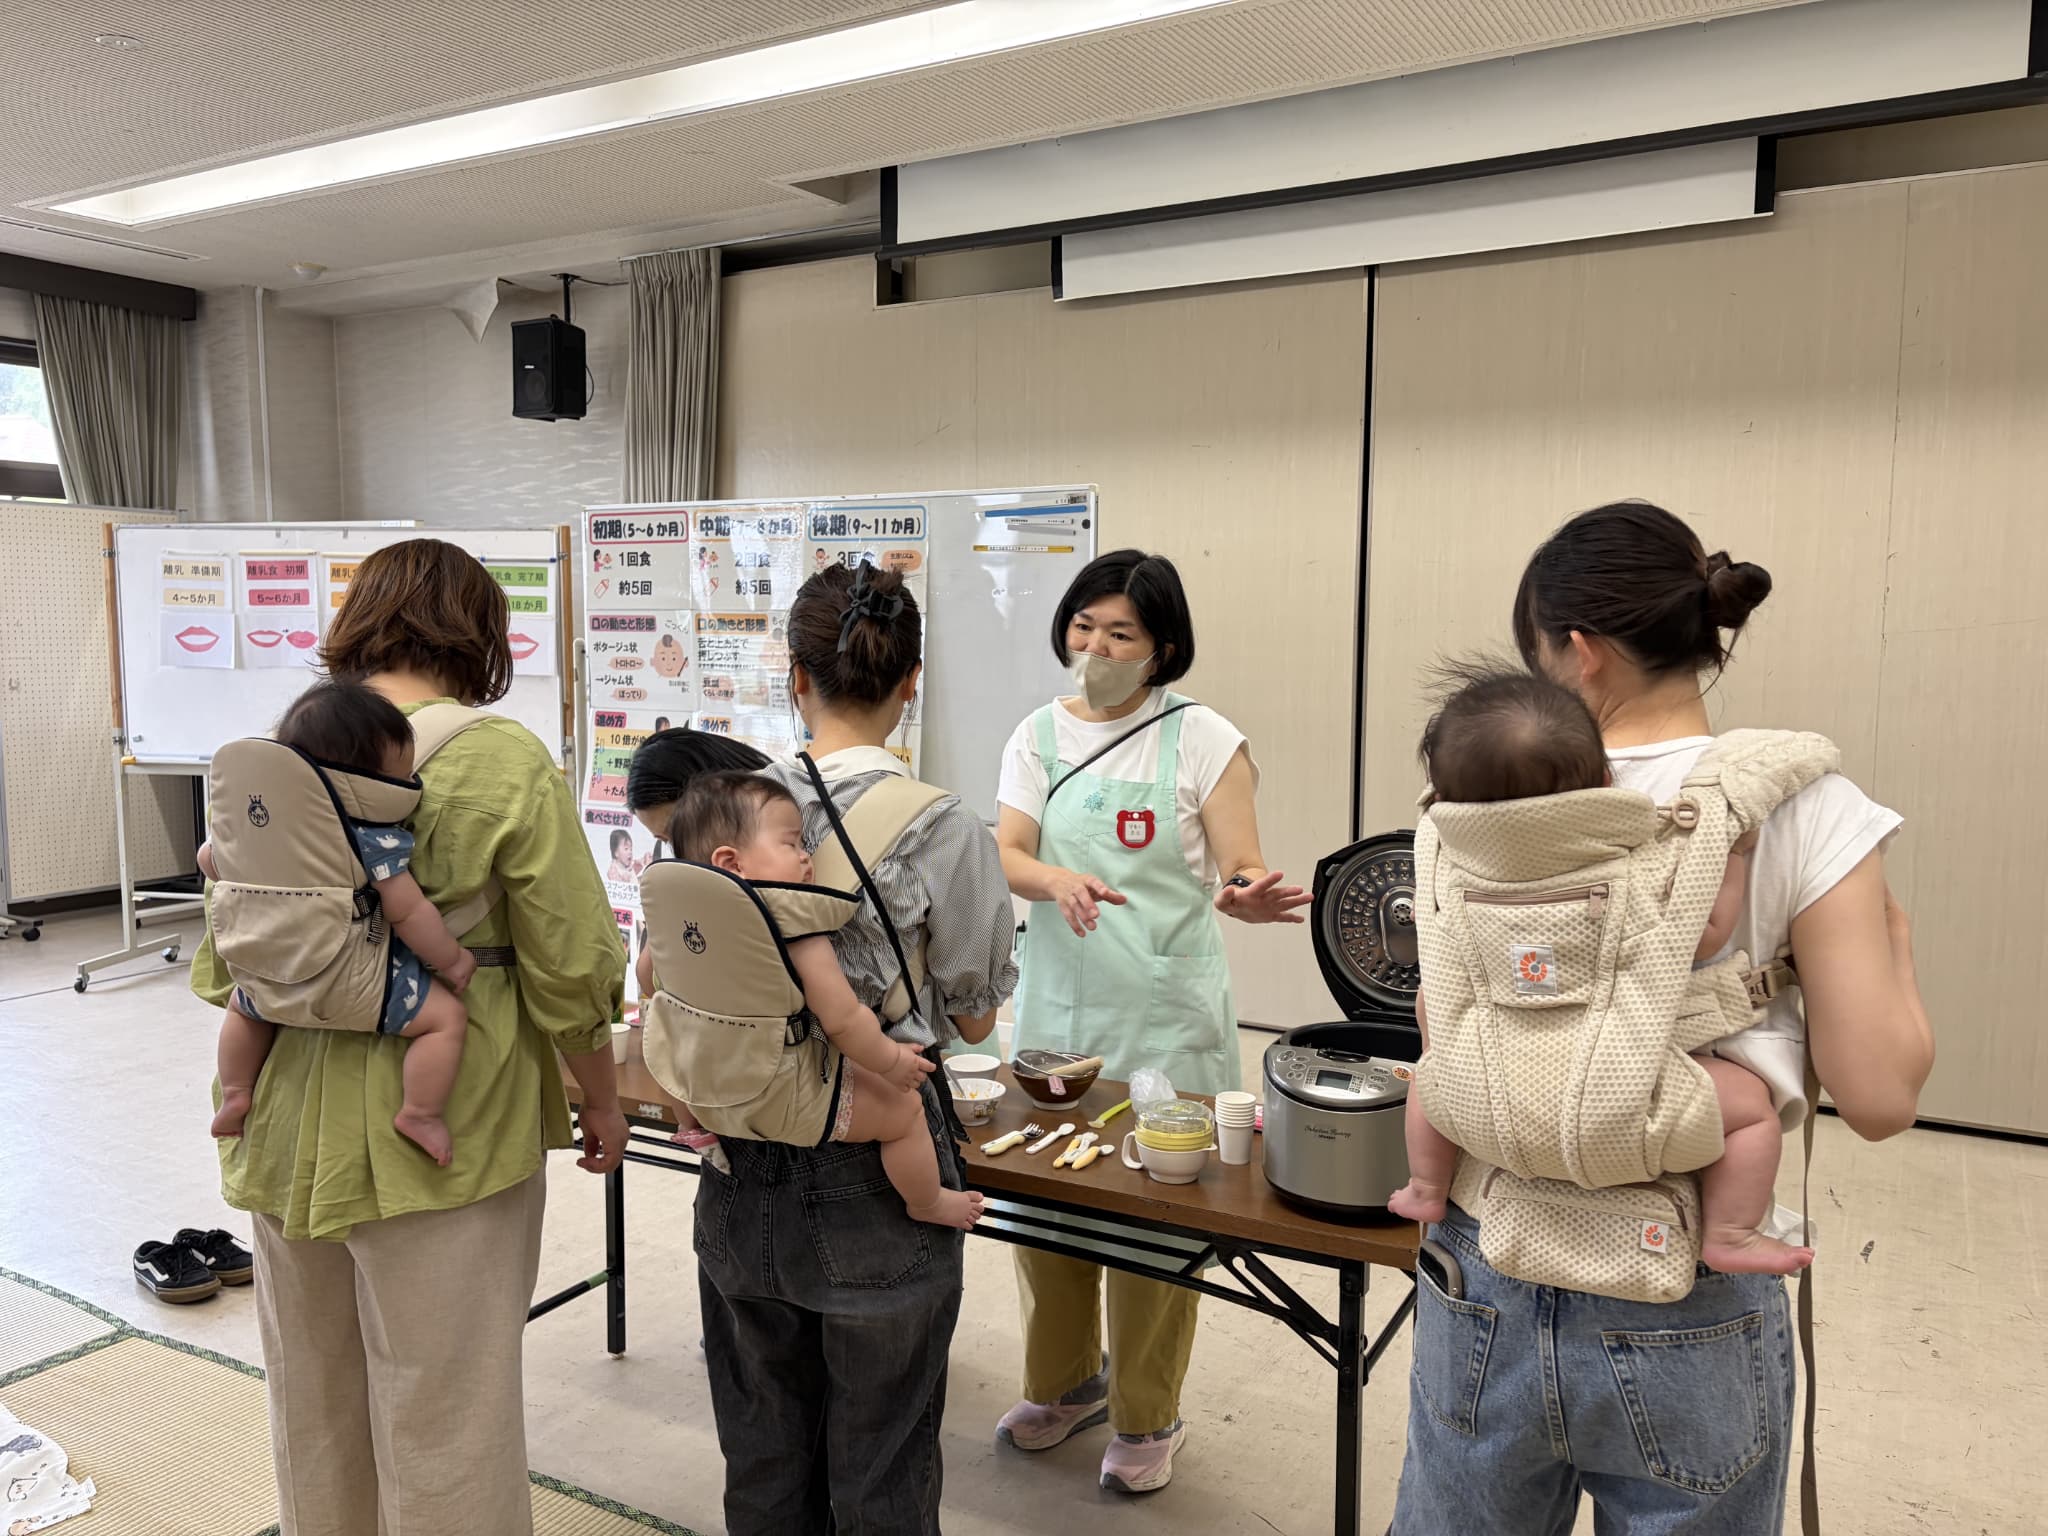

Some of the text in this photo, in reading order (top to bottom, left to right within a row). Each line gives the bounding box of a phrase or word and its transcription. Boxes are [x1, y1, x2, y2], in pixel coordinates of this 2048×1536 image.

[618, 550, 651, 567] 1回食
[163, 564, 222, 577] 離乳 準備期
[247, 565, 305, 576] 離乳食 初期
[331, 567, 356, 578] 離乳
[618, 580, 652, 596] 約5回
[735, 579, 771, 595] 約5回
